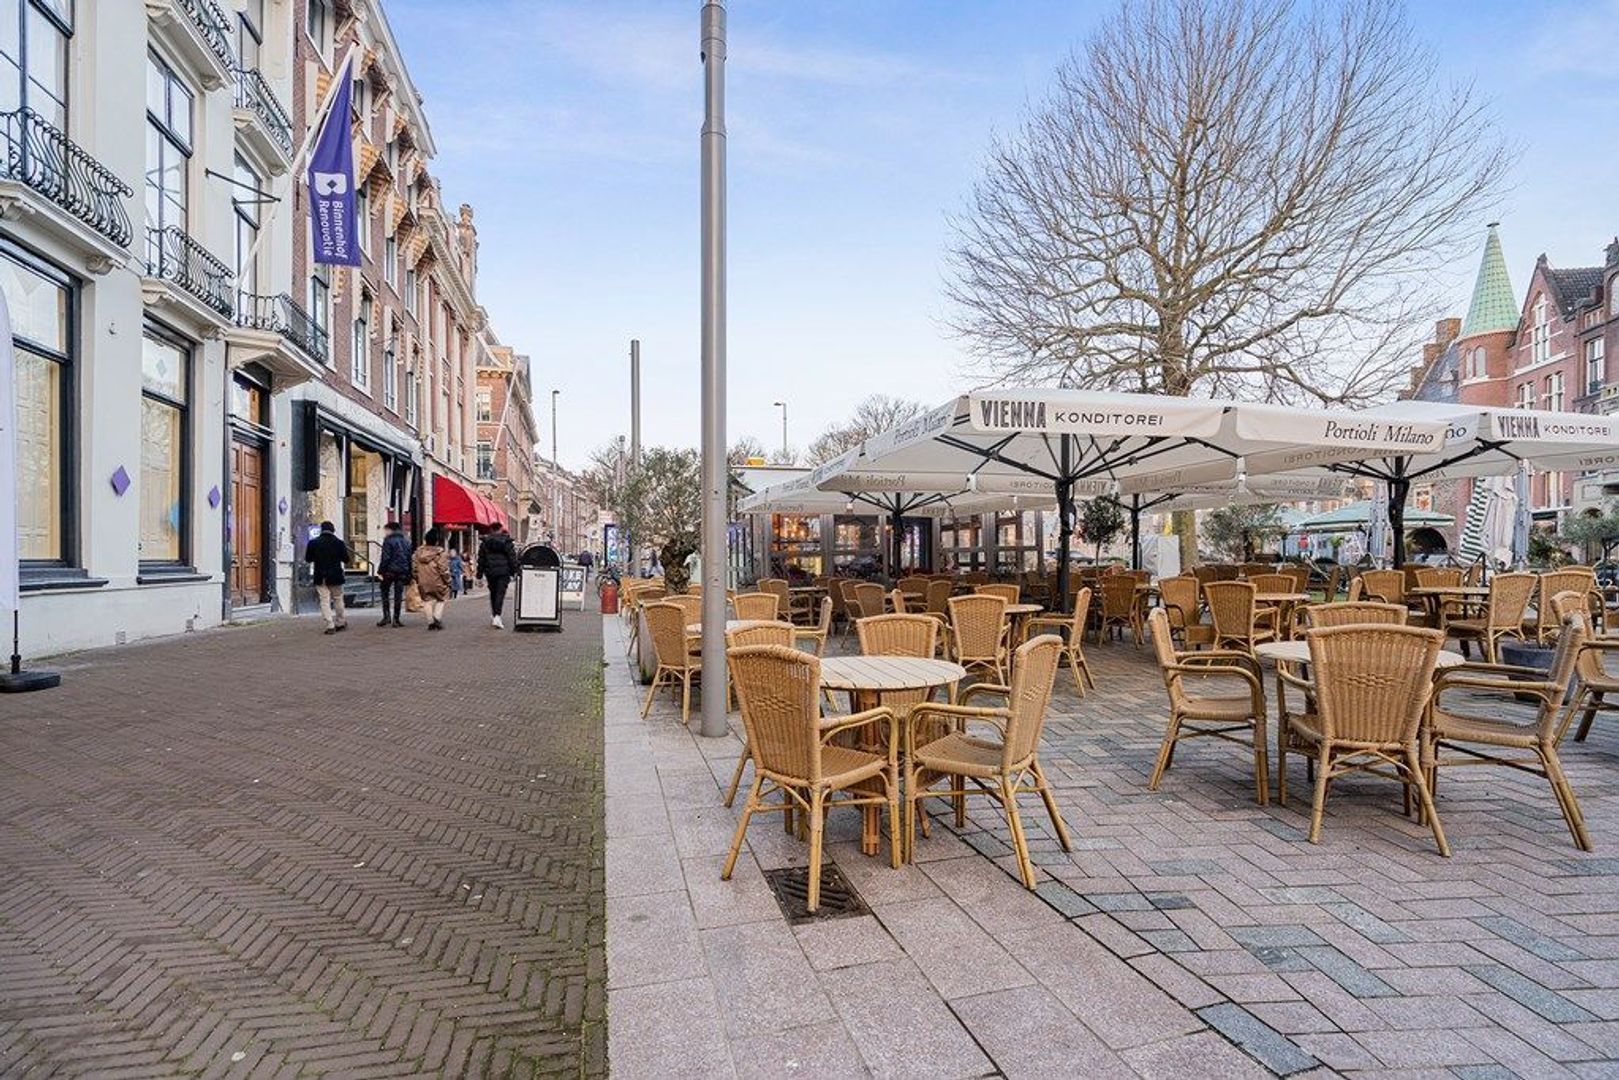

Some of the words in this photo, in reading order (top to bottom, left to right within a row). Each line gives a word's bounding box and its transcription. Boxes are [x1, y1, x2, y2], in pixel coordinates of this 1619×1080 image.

[319, 200, 335, 256] Renovatie
[332, 200, 349, 259] Binnenhof
[981, 400, 1047, 429] VIENNA
[1056, 412, 1163, 426] KONDITOREI
[1497, 416, 1541, 438] VIENNA
[1544, 424, 1611, 436] KONDITOREI
[1325, 421, 1379, 442] Portioli
[1383, 425, 1434, 446] Milano
